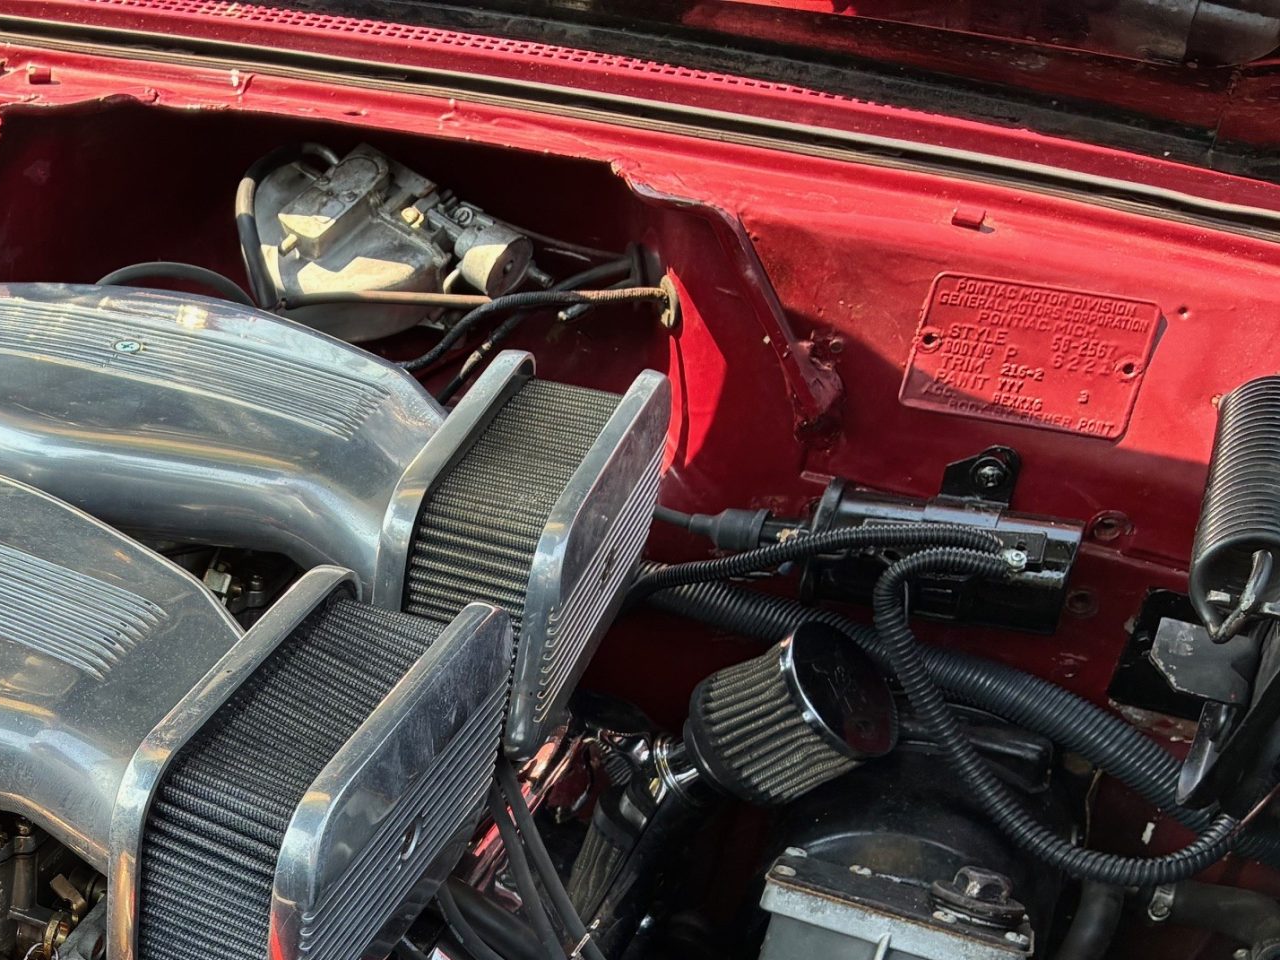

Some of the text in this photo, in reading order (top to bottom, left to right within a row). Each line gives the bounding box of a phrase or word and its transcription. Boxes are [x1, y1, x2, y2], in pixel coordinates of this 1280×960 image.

[939, 291, 1149, 332] GENERAL MOTORS CORPORATION
[957, 278, 1137, 317] PONTIAC MOTOR DIVISION
[950, 323, 1008, 345] STYLE
[943, 338, 978, 357] BODY
[1004, 344, 1019, 363] P
[940, 353, 1045, 381] TRIM 216-2
[934, 369, 1090, 404] PAINT YYY 3
[1020, 410, 1073, 429] FISHER
[1077, 416, 1115, 437] PONT
